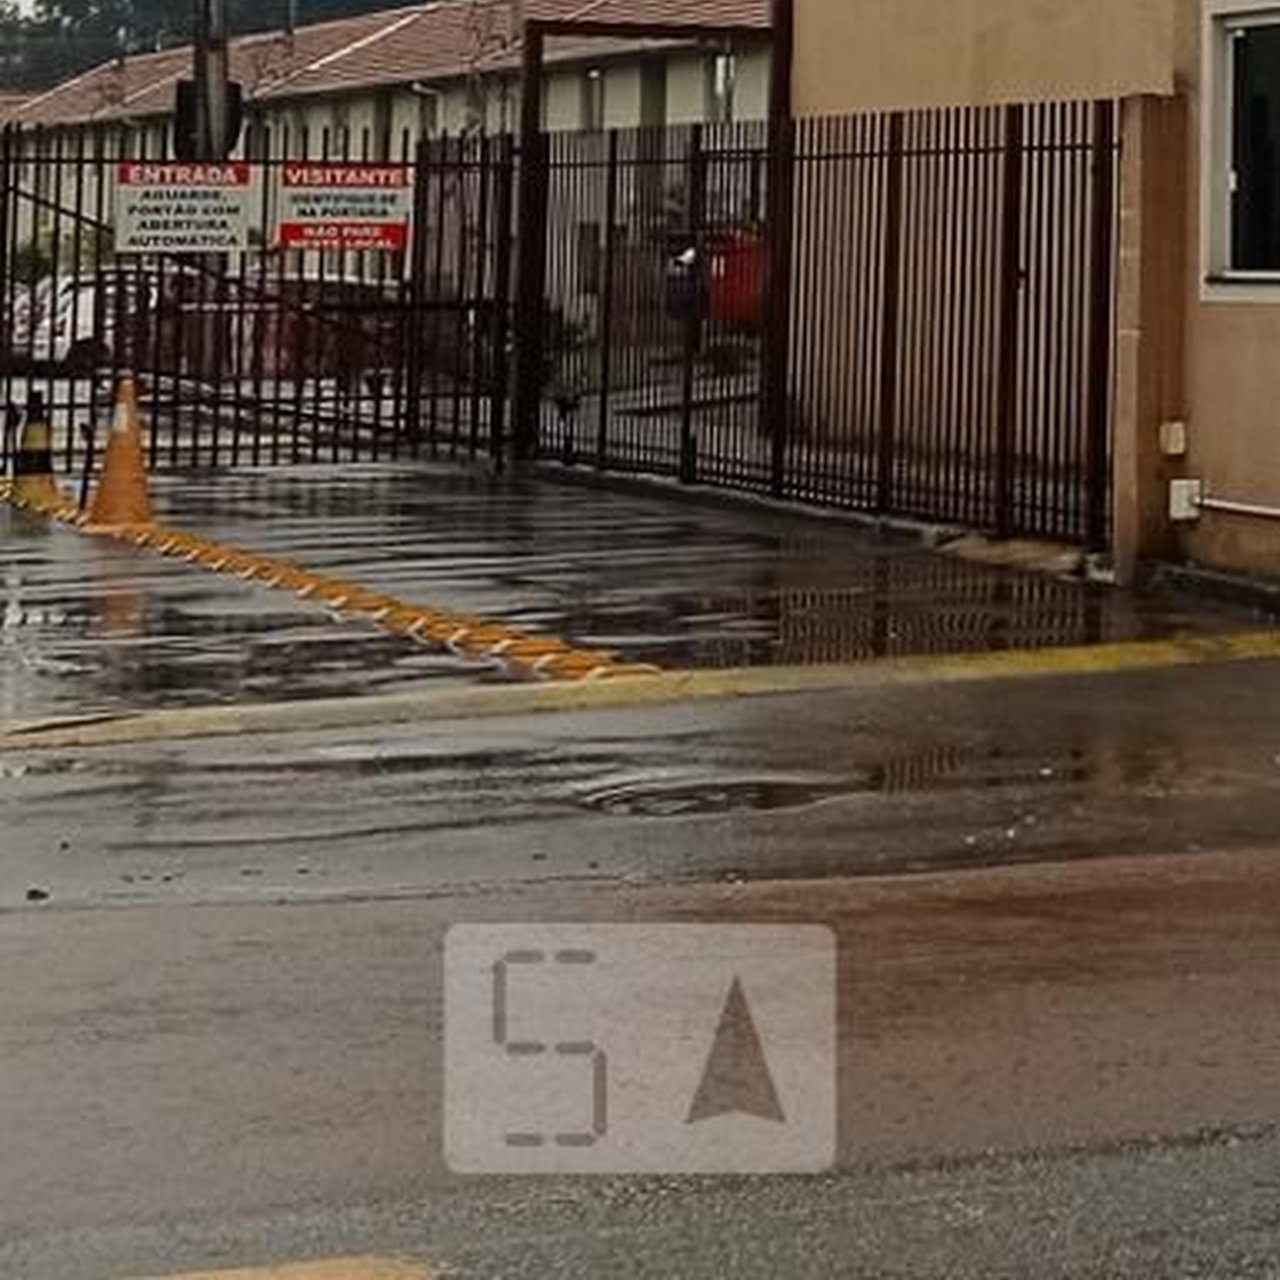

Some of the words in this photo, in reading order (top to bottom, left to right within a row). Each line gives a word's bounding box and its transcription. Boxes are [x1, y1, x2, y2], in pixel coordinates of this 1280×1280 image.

[128, 165, 238, 183] ENTRADA
[286, 169, 403, 184] VISITANTE
[128, 203, 197, 215] PORTÃO
[202, 205, 240, 215] COM
[137, 220, 229, 231] ABERTURA
[128, 234, 238, 246] AUTOMÁTICA
